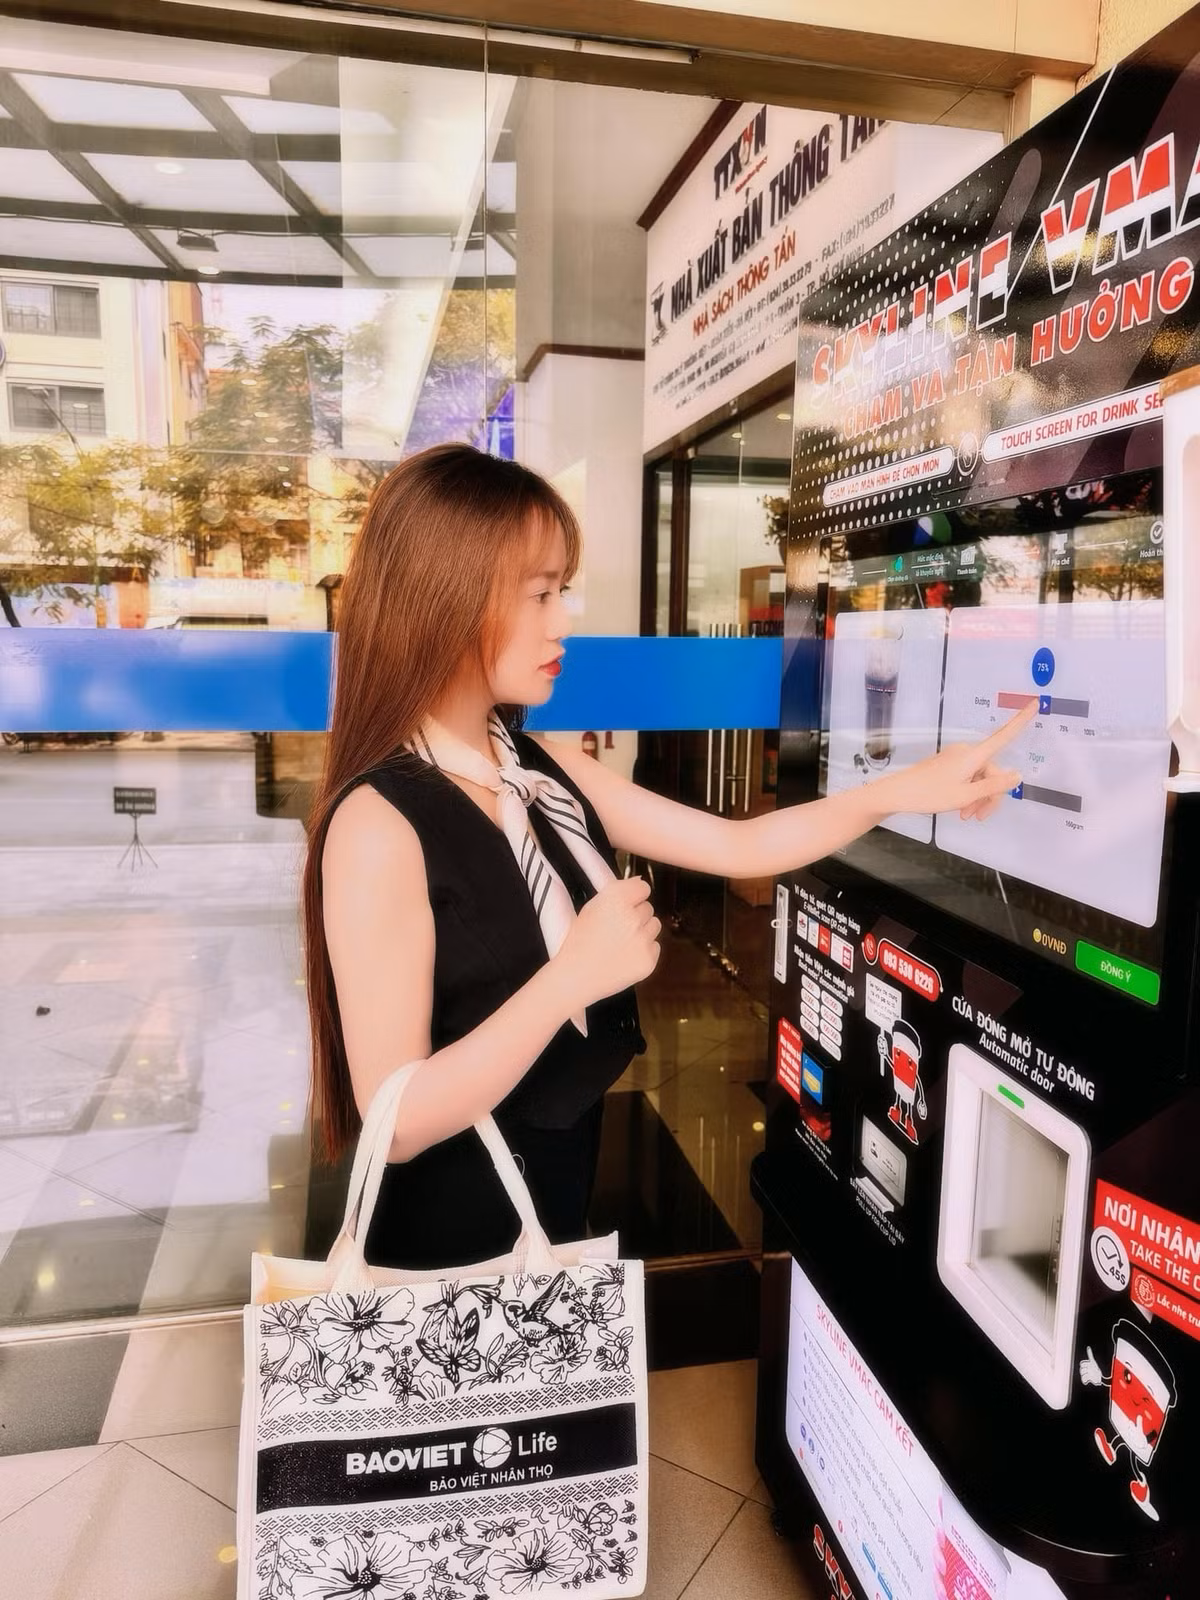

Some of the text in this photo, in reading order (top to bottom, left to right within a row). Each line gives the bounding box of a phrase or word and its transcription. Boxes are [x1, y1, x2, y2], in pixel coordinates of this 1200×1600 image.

[696, 219, 728, 298] XUẤT
[769, 123, 830, 228] THÔNG
[693, 226, 796, 338] NHÀ SÁCH THÔNG TẤN
[812, 231, 1012, 409] SKYLINE
[912, 361, 946, 413] VÀ
[955, 332, 1017, 396] TẬN
[1030, 256, 1195, 367] HƯỞNG
[1000, 430, 1032, 450] TOUCH
[1035, 418, 1073, 442] SCREEN
[1076, 410, 1098, 430] FOR
[1102, 397, 1139, 424] DRINK
[922, 457, 940, 473] MÓN
[1037, 662, 1050, 672] 75%
[1042, 933, 1067, 955] 0VNĐ
[1100, 960, 1132, 983] ĐỒNG Ý
[952, 995, 1095, 1101] CỬA ĐÓNG MỞ TỰ ĐỘNG
[979, 1032, 1055, 1093] Automatic door
[1104, 1195, 1200, 1265] NƠI NHẬN
[1109, 1265, 1126, 1286] 45S
[1129, 1239, 1162, 1269] TAKE
[1164, 1256, 1191, 1286] THE
[1156, 1293, 1171, 1309] Lắc
[1171, 1302, 1187, 1320] nhẹ
[816, 1304, 847, 1360] SKYLINE
[848, 1349, 873, 1396] VMAC
[874, 1390, 893, 1428] CAM
[896, 1419, 914, 1457] KẾT
[346, 1432, 557, 1476] BAOVIET Life
[429, 1464, 554, 1492] BẢO VIỆT NHÂN THỌ
